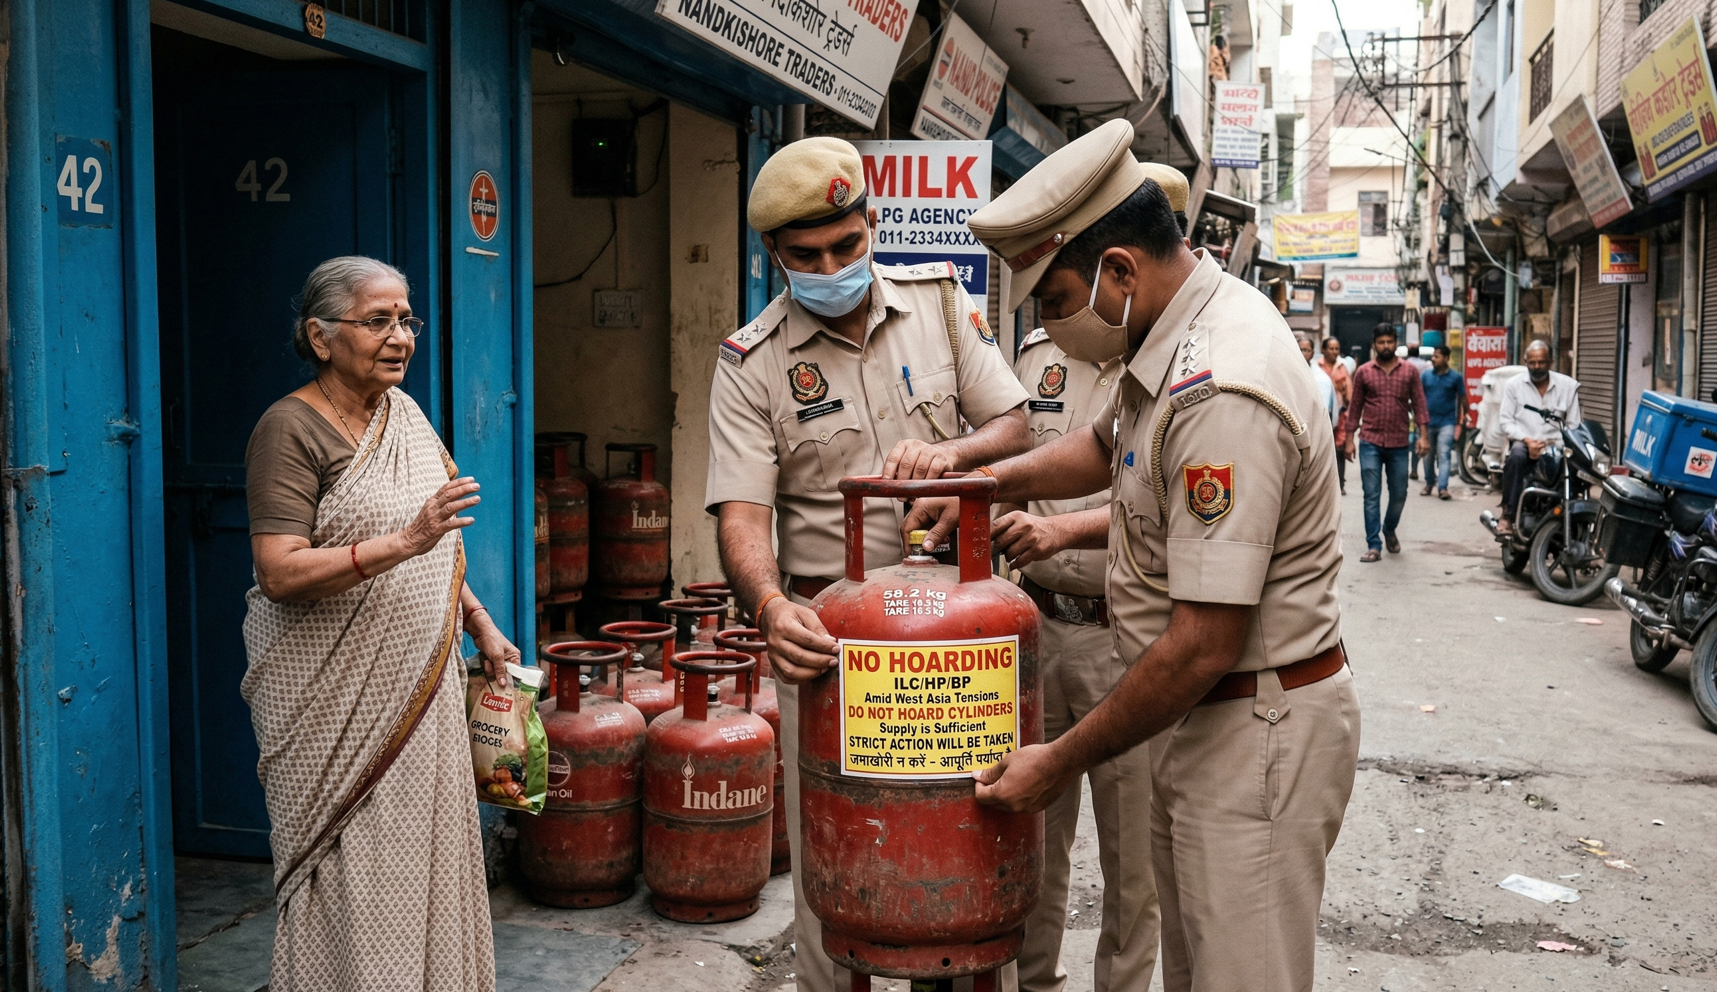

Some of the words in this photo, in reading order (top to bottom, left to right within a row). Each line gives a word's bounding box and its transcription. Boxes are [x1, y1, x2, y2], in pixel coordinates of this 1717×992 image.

[308, 12, 323, 29] 42
[784, 48, 836, 97] TRADERS
[56, 154, 104, 214] 42
[235, 157, 291, 202] 42
[862, 155, 979, 199] MILK
[876, 207, 904, 224] PG
[1632, 428, 1657, 458] MILK
[883, 588, 920, 599] 58.2
[926, 588, 947, 600] kg
[883, 607, 910, 617] TARE
[933, 607, 945, 618] kg
[884, 599, 910, 608] TARE
[933, 599, 945, 610] kg
[848, 650, 880, 672] NO
[889, 647, 1012, 673] HOARDING
[894, 676, 971, 690] ILC/HP/BP
[865, 692, 891, 704] Amid
[895, 693, 923, 704] West
[926, 693, 951, 704] Asia
[954, 691, 999, 703] Tensions
[849, 705, 864, 719] DO
[868, 706, 894, 720] NOT
[898, 708, 944, 721] HOARD
[948, 702, 1012, 720] CYLINDERS
[471, 719, 510, 737] GROCERY
[880, 722, 917, 736] Supply
[921, 722, 930, 734] is
[934, 720, 986, 734] Sufficient
[849, 735, 886, 750] STRICT
[889, 738, 933, 751] ACTION
[937, 737, 963, 750] WILL
[967, 736, 980, 749] BE
[983, 732, 1013, 747] TAKEN
[850, 752, 893, 768] जमाखोरी
[896, 754, 905, 768] न
[908, 753, 926, 768] करें
[940, 751, 973, 771] आपूर्ति
[558, 788, 573, 799] Oil
[682, 779, 767, 811] Indane
